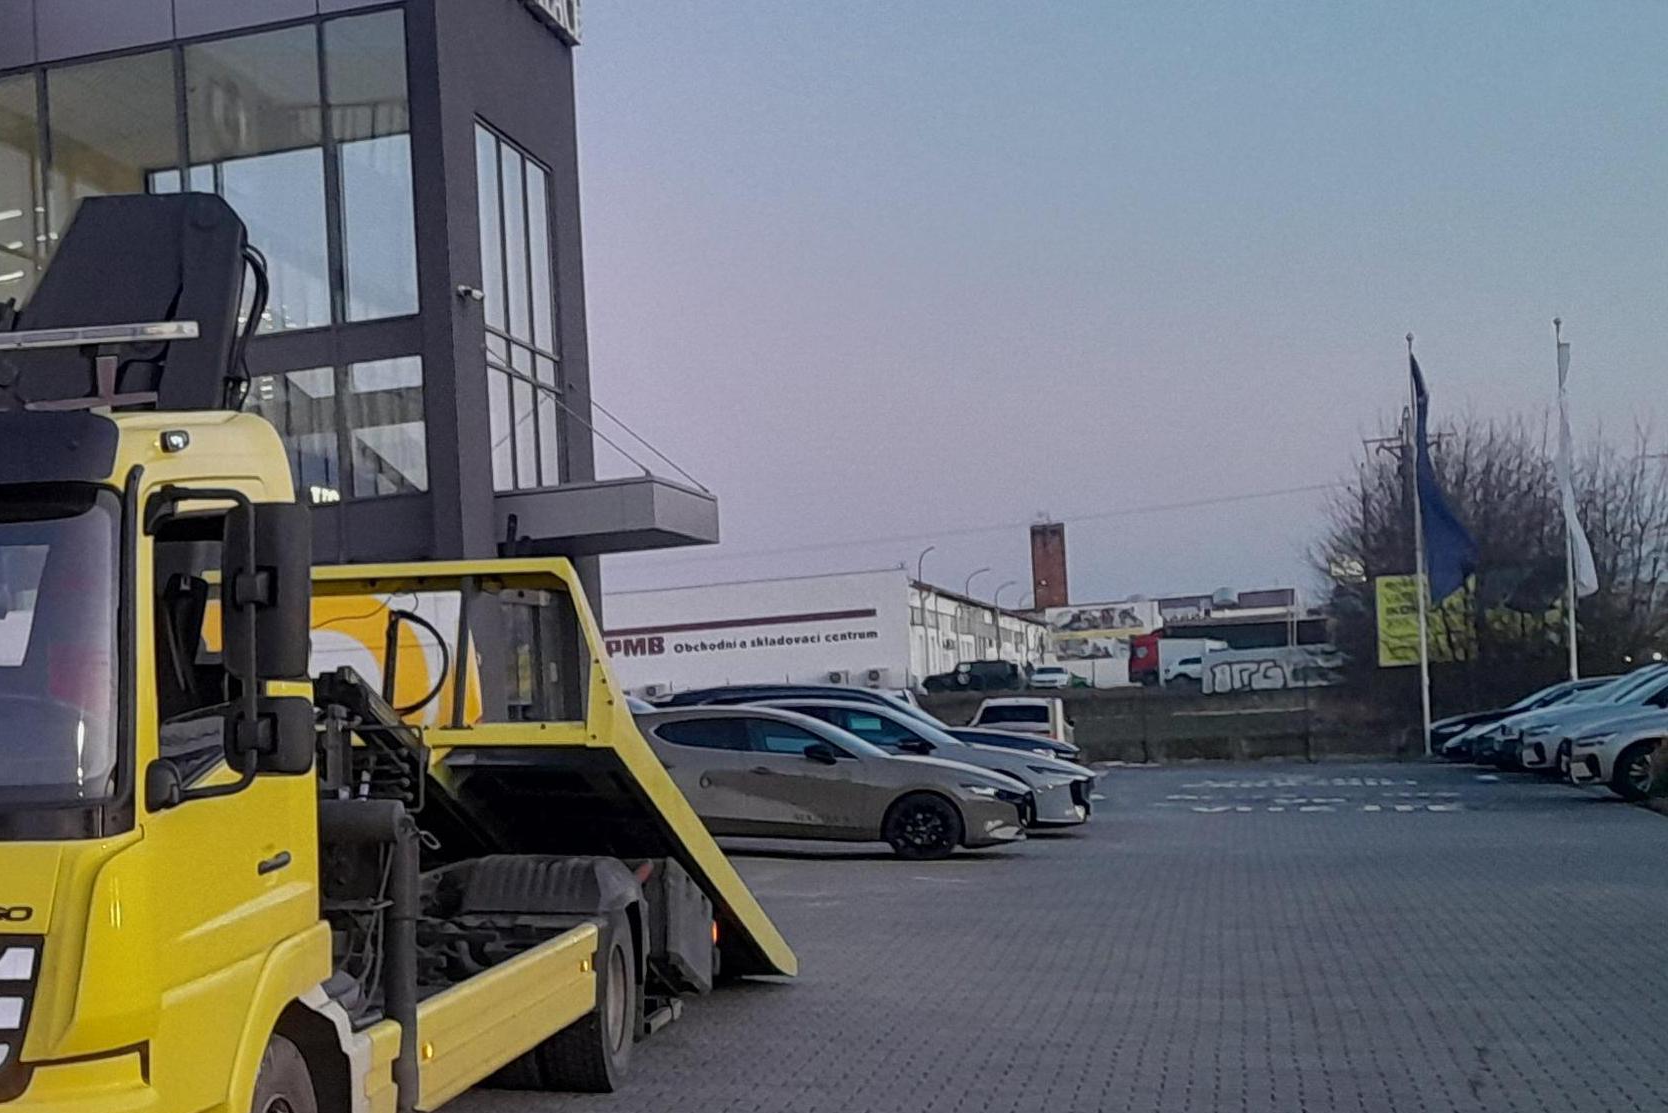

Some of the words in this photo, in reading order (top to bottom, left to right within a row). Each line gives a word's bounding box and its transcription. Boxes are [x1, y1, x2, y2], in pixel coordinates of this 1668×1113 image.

[604, 636, 666, 658] PMB
[739, 640, 747, 649] a
[824, 630, 879, 643] centrum
